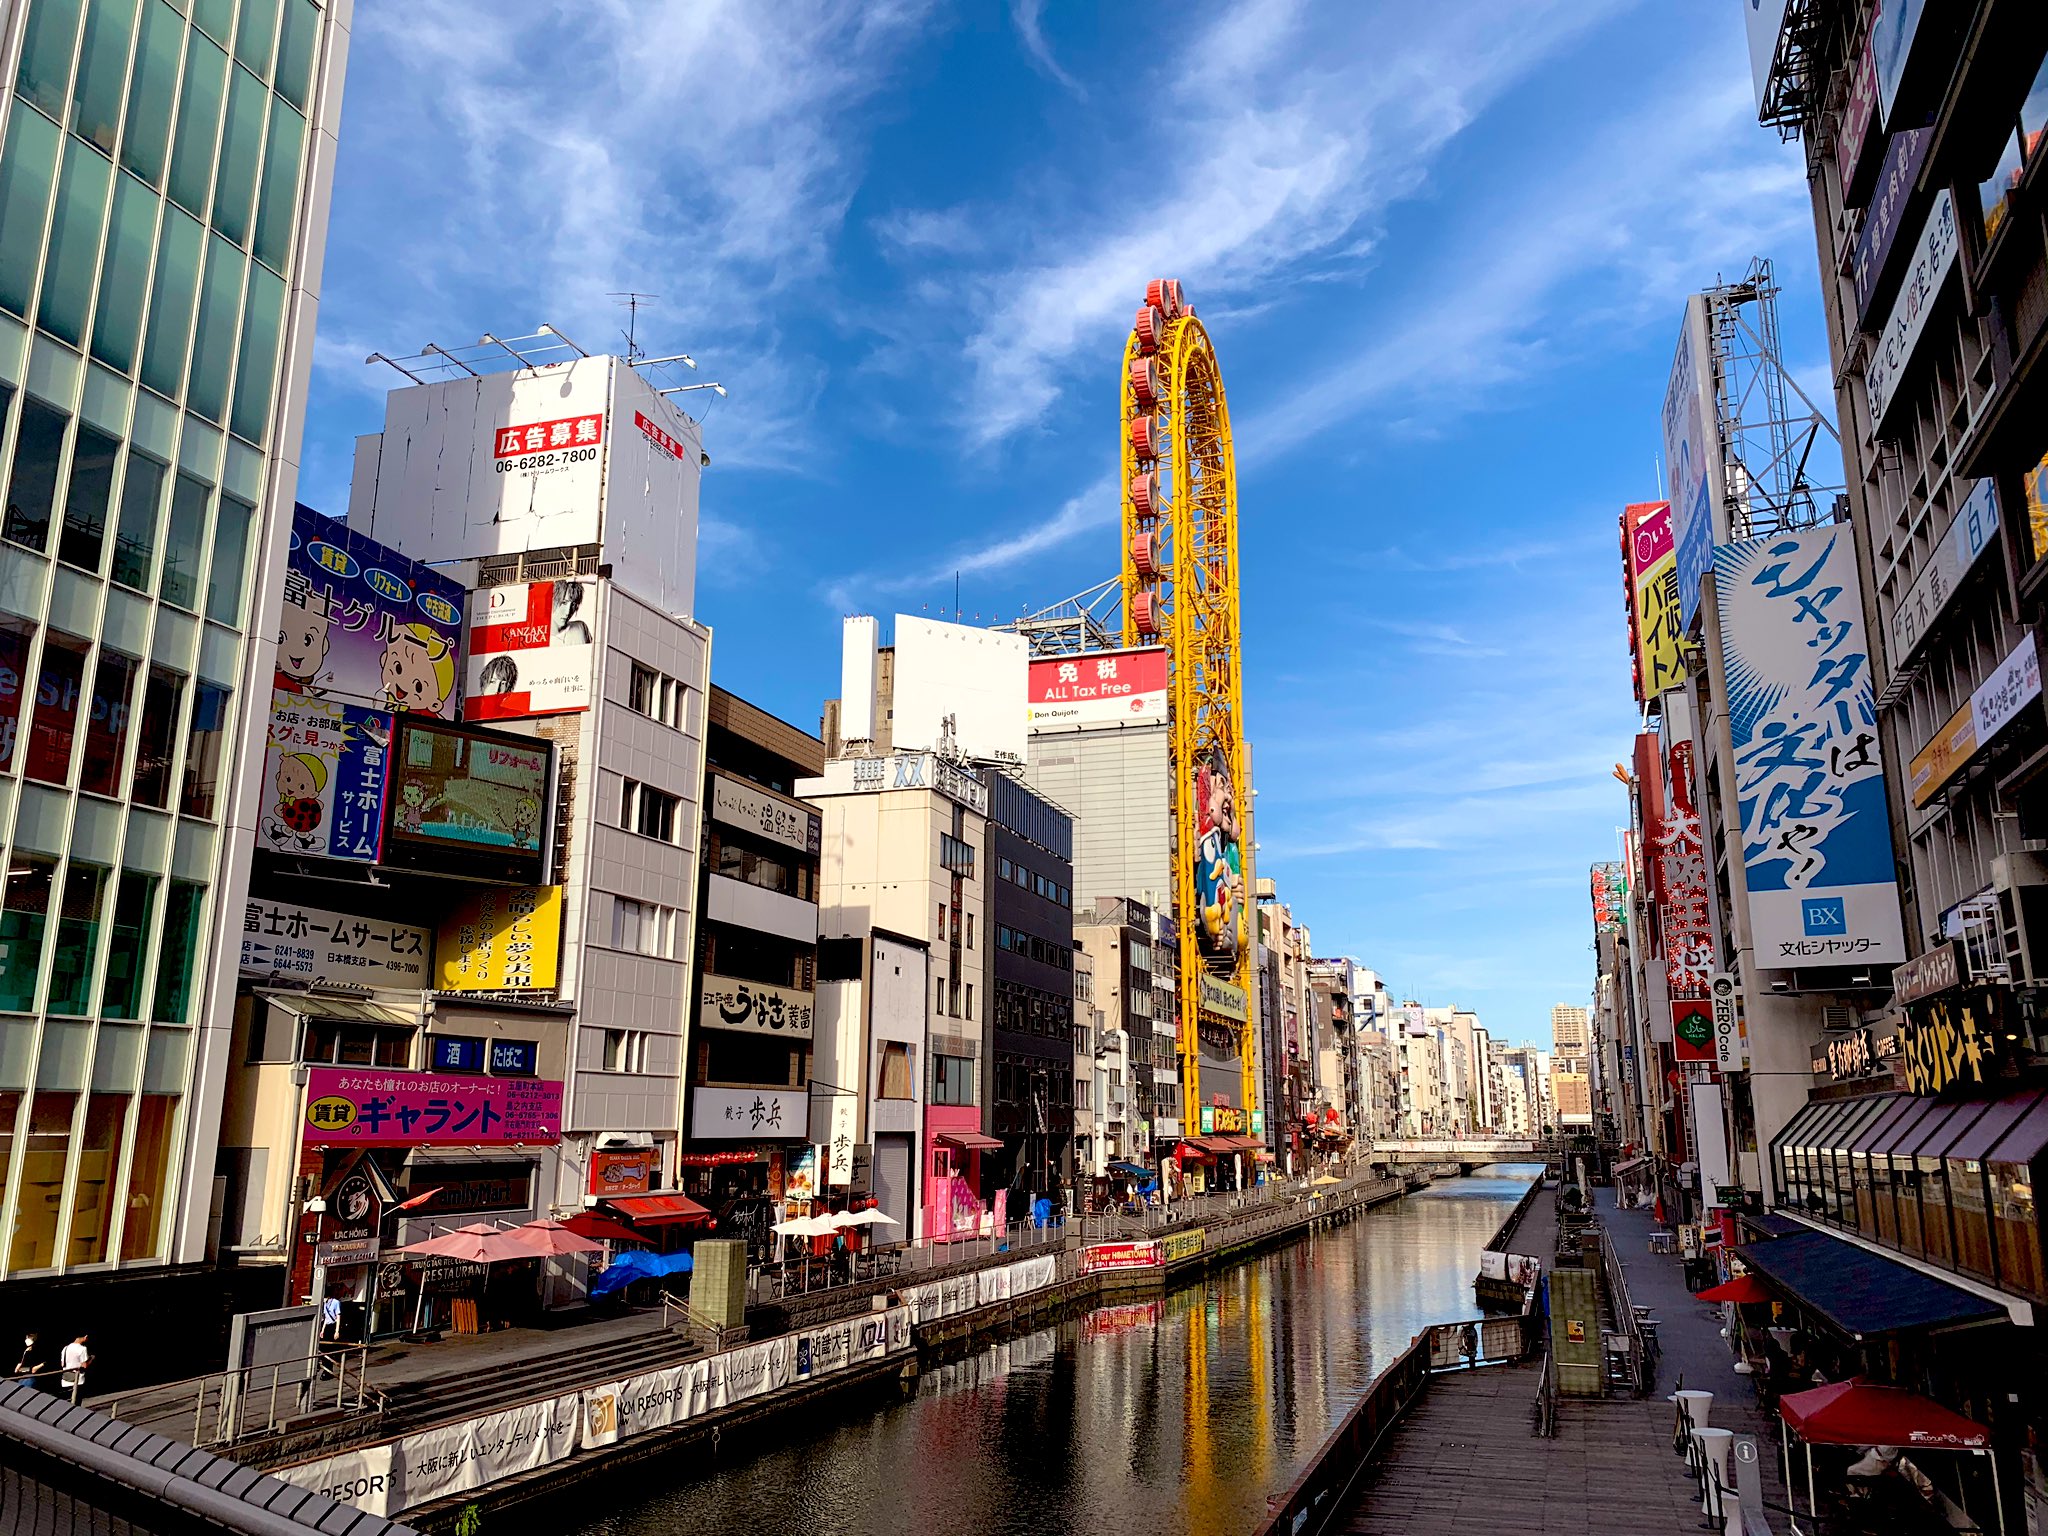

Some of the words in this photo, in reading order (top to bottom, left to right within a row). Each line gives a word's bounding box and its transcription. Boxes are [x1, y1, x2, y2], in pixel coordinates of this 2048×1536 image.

[499, 419, 598, 454] 広告募集
[642, 418, 676, 453] 広告募集
[496, 448, 597, 474] 06-6282-7800
[320, 545, 348, 575] 賃貸
[374, 570, 403, 600] リフォーム
[283, 569, 455, 663] 富士グループ
[1905, 566, 1943, 648] 白木屋
[1643, 577, 1668, 690] バイト
[1751, 531, 1880, 778] シャッターは
[1058, 659, 1118, 683] 免税
[1044, 687, 1068, 700] ALL
[1072, 685, 1097, 698] Tax
[1101, 682, 1132, 695] Free
[275, 710, 342, 733] お店・お部屋
[1051, 709, 1079, 719] Quijote
[488, 750, 541, 772] リフォーム
[352, 745, 384, 856] 富士ホーム
[336, 790, 355, 848] サービス
[1653, 806, 1715, 990] 大阪王将
[243, 903, 423, 957] 富士ホームサービス
[1807, 907, 1841, 927] BX
[274, 944, 315, 960] 6241-8839
[327, 952, 367, 967] 日本橋支店
[1779, 938, 1882, 957] 文化シャッター
[272, 957, 314, 973] 6644-5573
[719, 984, 787, 1029] うなぎ
[1715, 999, 1732, 1035] ZERO
[446, 1042, 460, 1065] 酒
[492, 1046, 523, 1068] たばこ
[1719, 1035, 1731, 1063] cafe
[1876, 1035, 1896, 1057] COFFEE
[313, 1103, 351, 1123] 賃貸
[351, 1124, 362, 1135] の
[357, 1095, 502, 1134] ギャラント
[724, 1105, 745, 1121] 餃子
[748, 1095, 782, 1131] 歩兵
[832, 1133, 852, 1173] 歩兵
[424, 1263, 488, 1282] RESTAURANT
[811, 1327, 851, 1358] 近畿大学
[637, 1386, 684, 1412] RESORTS
